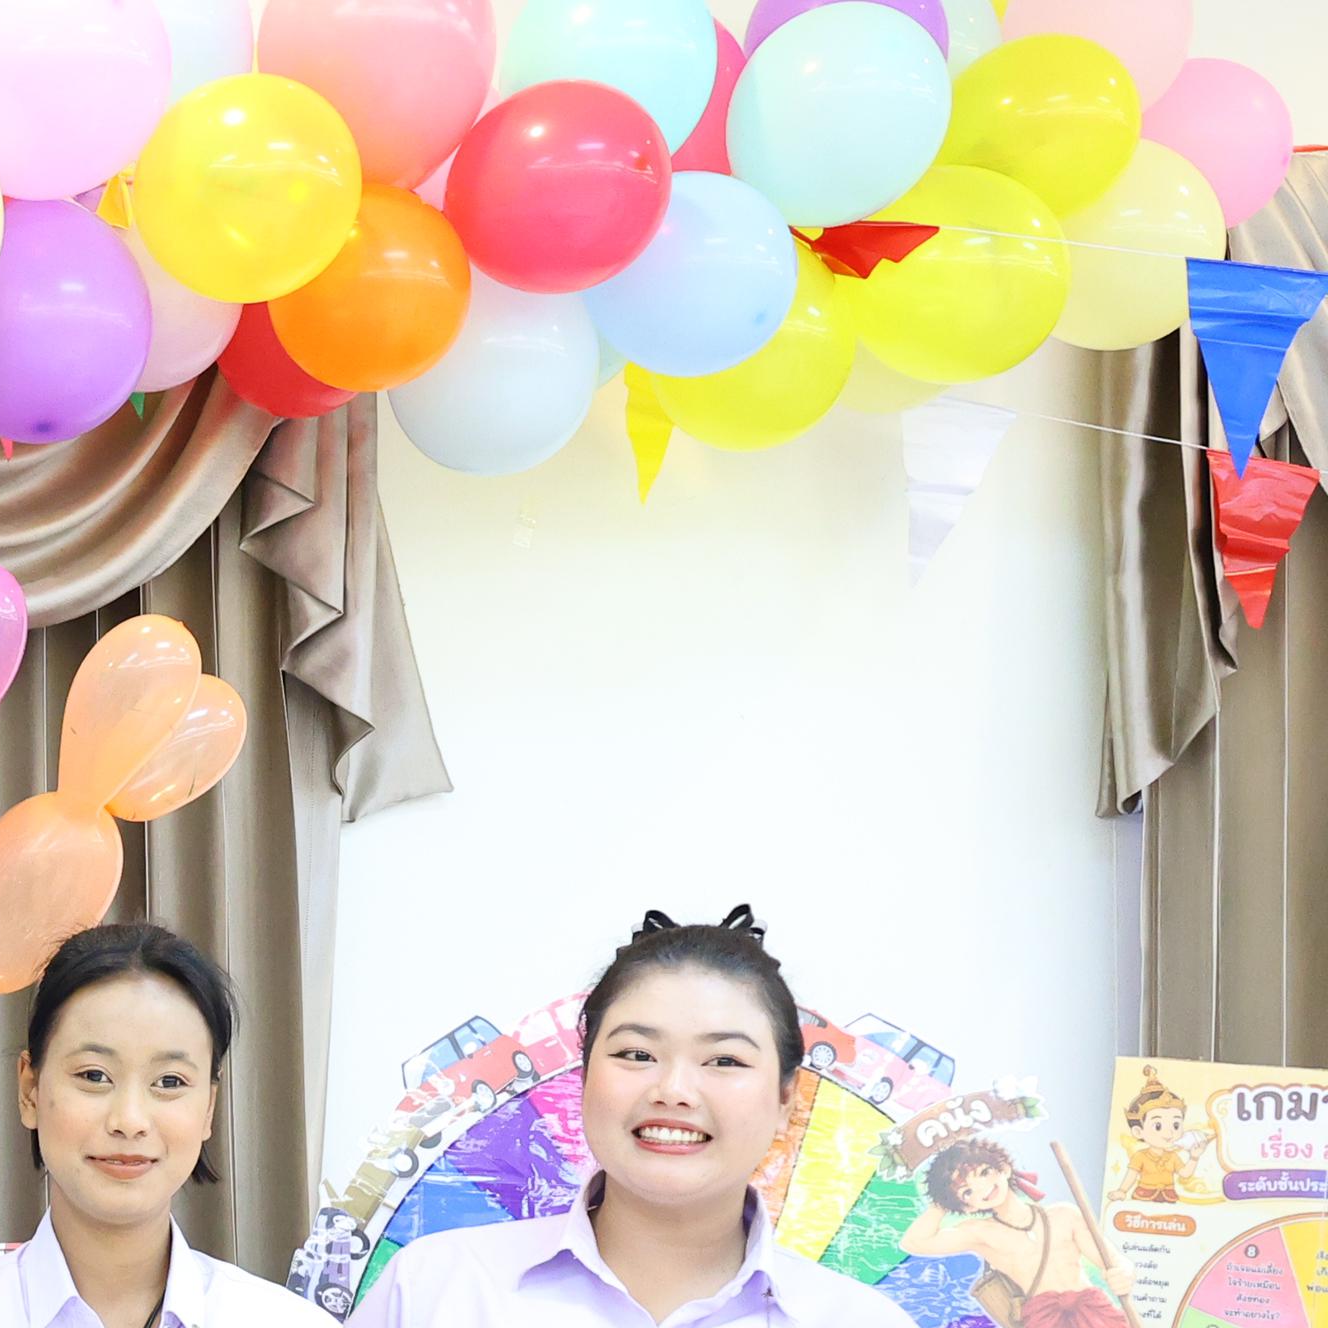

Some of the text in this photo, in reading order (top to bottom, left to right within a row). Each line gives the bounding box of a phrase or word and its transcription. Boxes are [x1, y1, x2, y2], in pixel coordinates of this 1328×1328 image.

[916, 1096, 993, 1147] คนัง
[1237, 1091, 1328, 1122] เกม
[1260, 1129, 1314, 1159] เรื่อง
[1237, 1173, 1328, 1193] ระดับชั้นประ
[1247, 1246, 1257, 1258] 8
